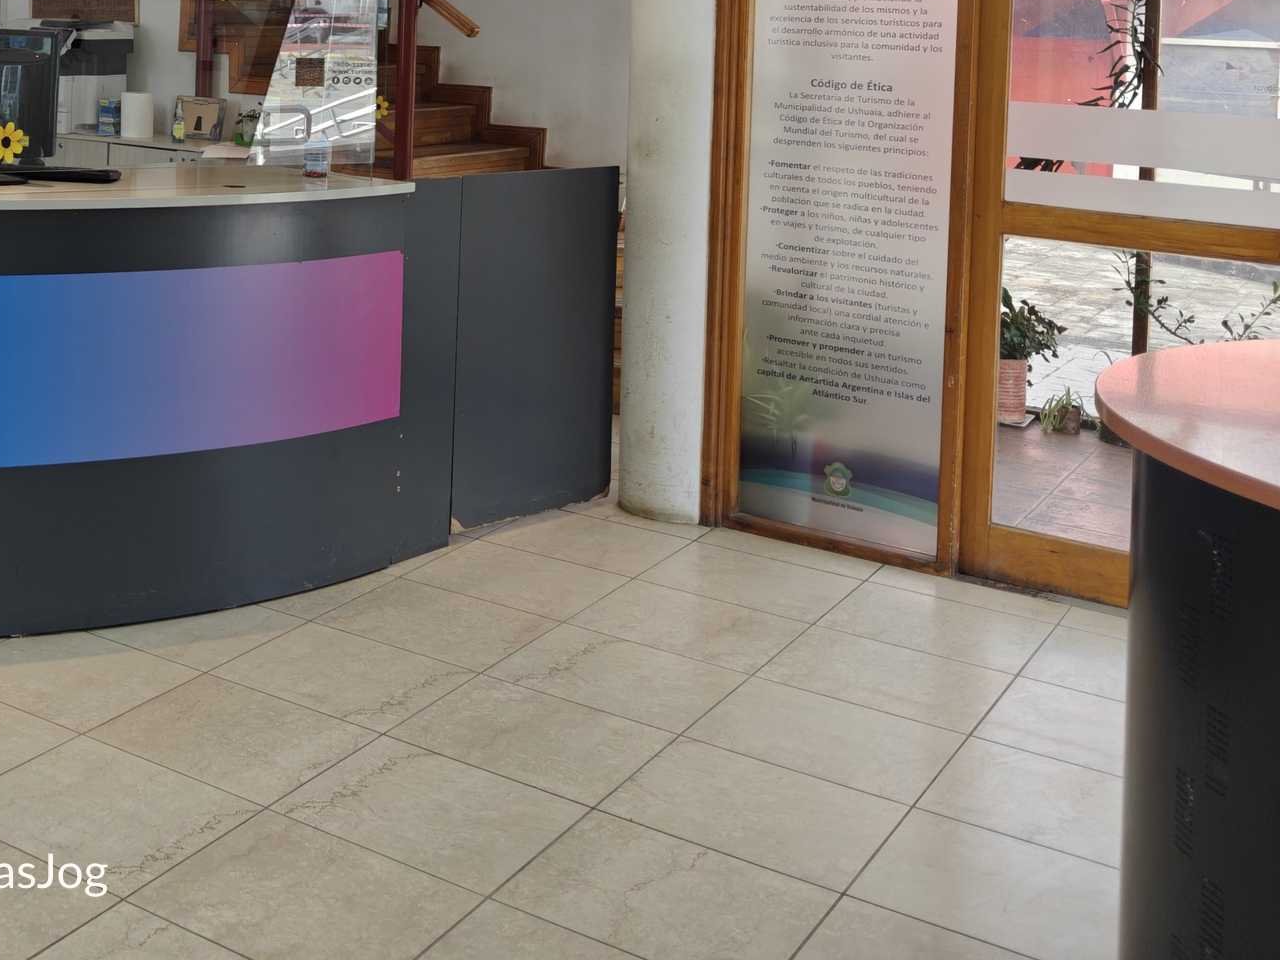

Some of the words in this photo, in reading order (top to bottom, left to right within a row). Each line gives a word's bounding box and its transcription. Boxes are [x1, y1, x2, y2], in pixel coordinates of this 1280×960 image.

[830, 52, 873, 62] visitantes.
[810, 78, 846, 92] Código
[850, 80, 863, 90] de
[866, 80, 892, 92] Ética
[789, 90, 798, 99] La
[800, 91, 841, 102] Secretaría
[843, 94, 854, 103] de
[857, 94, 891, 105] Turismo
[893, 96, 904, 106] de
[907, 97, 914, 106] la
[774, 101, 832, 114] Municipalidad
[834, 105, 845, 114] de
[847, 106, 884, 118] Ushuaia,
[886, 108, 920, 119] adhiere
[922, 110, 930, 119] al
[779, 113, 807, 126] Código
[809, 115, 820, 124] de
[822, 115, 842, 126] Ética
[844, 117, 855, 126] de
[857, 118, 864, 127] la
[867, 119, 923, 131] Organización
[783, 125, 817, 136] Mundial
[819, 128, 832, 137] del
[835, 129, 871, 141] Turismo,
[872, 132, 886, 141] del
[888, 134, 906, 142] cual
[772, 136, 821, 149] desprenden
[823, 140, 835, 149] los
[838, 141, 880, 153] siguientes
[883, 145, 929, 158] principios:
[756, 369, 784, 380] capital
[786, 372, 796, 382] de
[798, 374, 839, 388] Antártida
[841, 381, 883, 396] Argentina
[894, 389, 913, 401] Islas
[916, 393, 930, 404] del
[812, 388, 850, 402] Atlántico
[852, 395, 869, 406] Sur.
